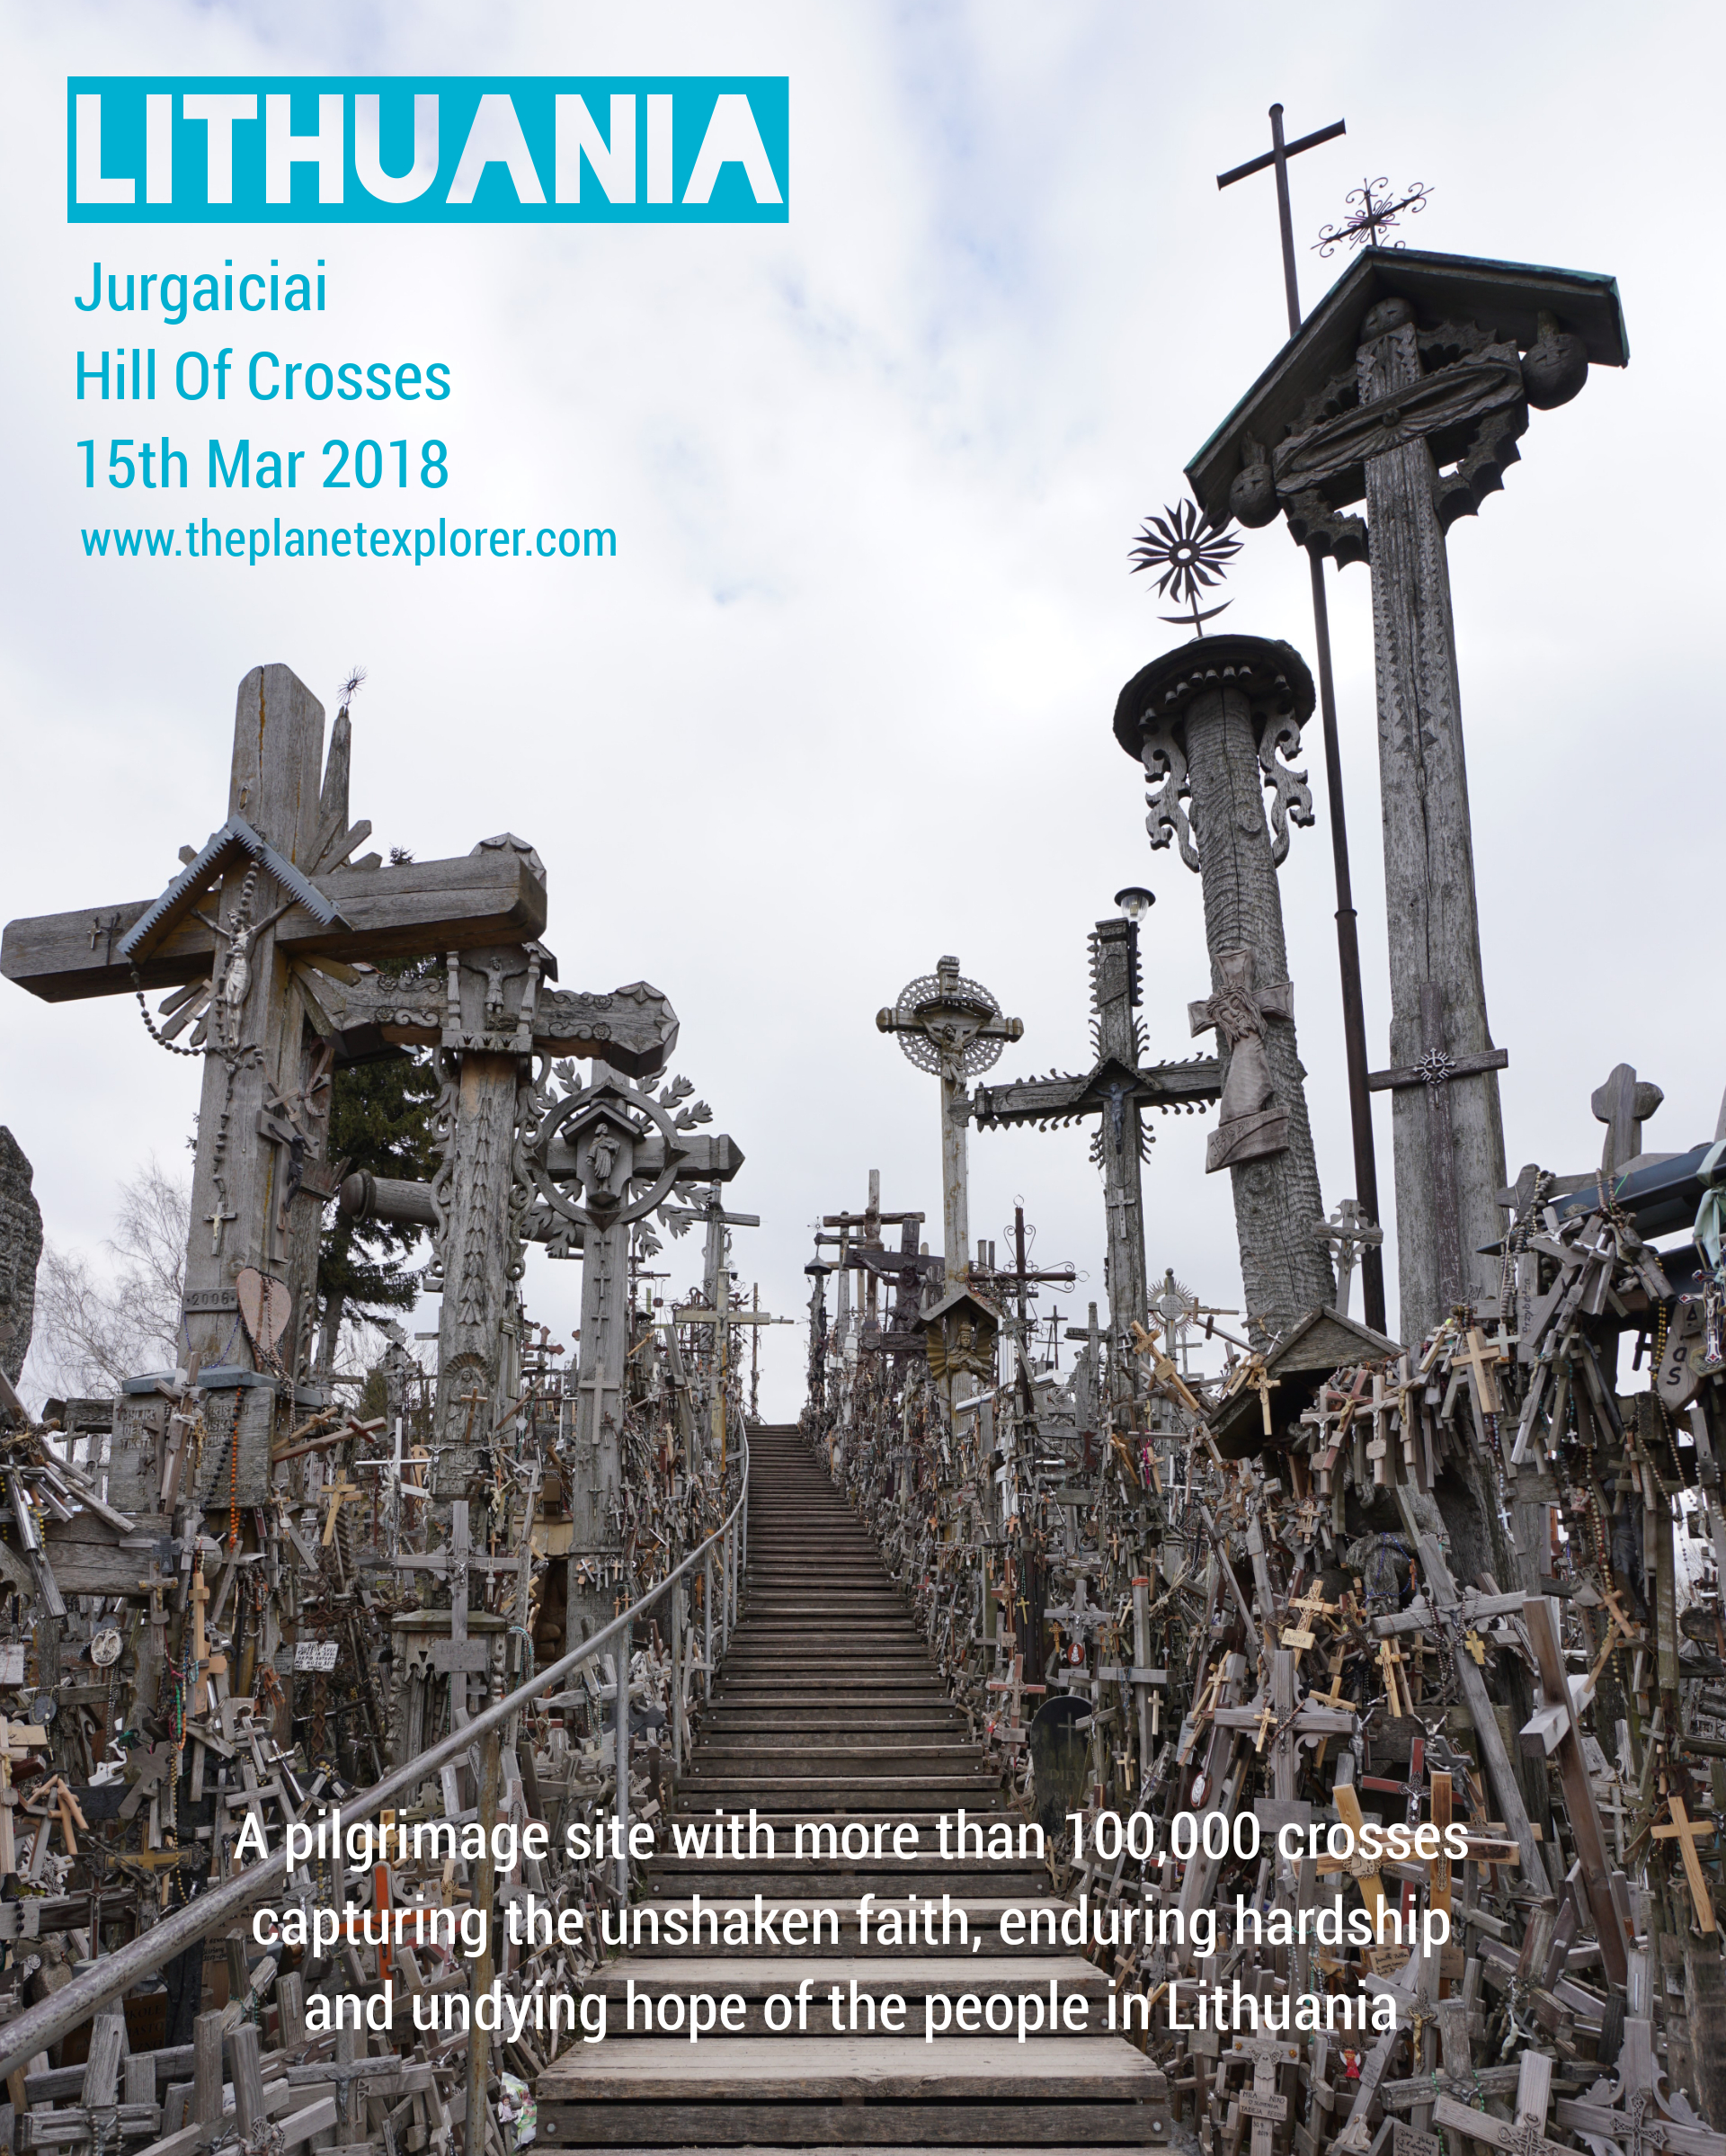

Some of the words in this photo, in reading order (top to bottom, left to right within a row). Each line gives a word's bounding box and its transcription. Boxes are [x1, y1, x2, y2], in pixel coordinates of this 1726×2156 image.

[191, 1292, 229, 1306] 2006
[1242, 2090, 1258, 2098] MILA
[1268, 2095, 1286, 2104] NIKO
